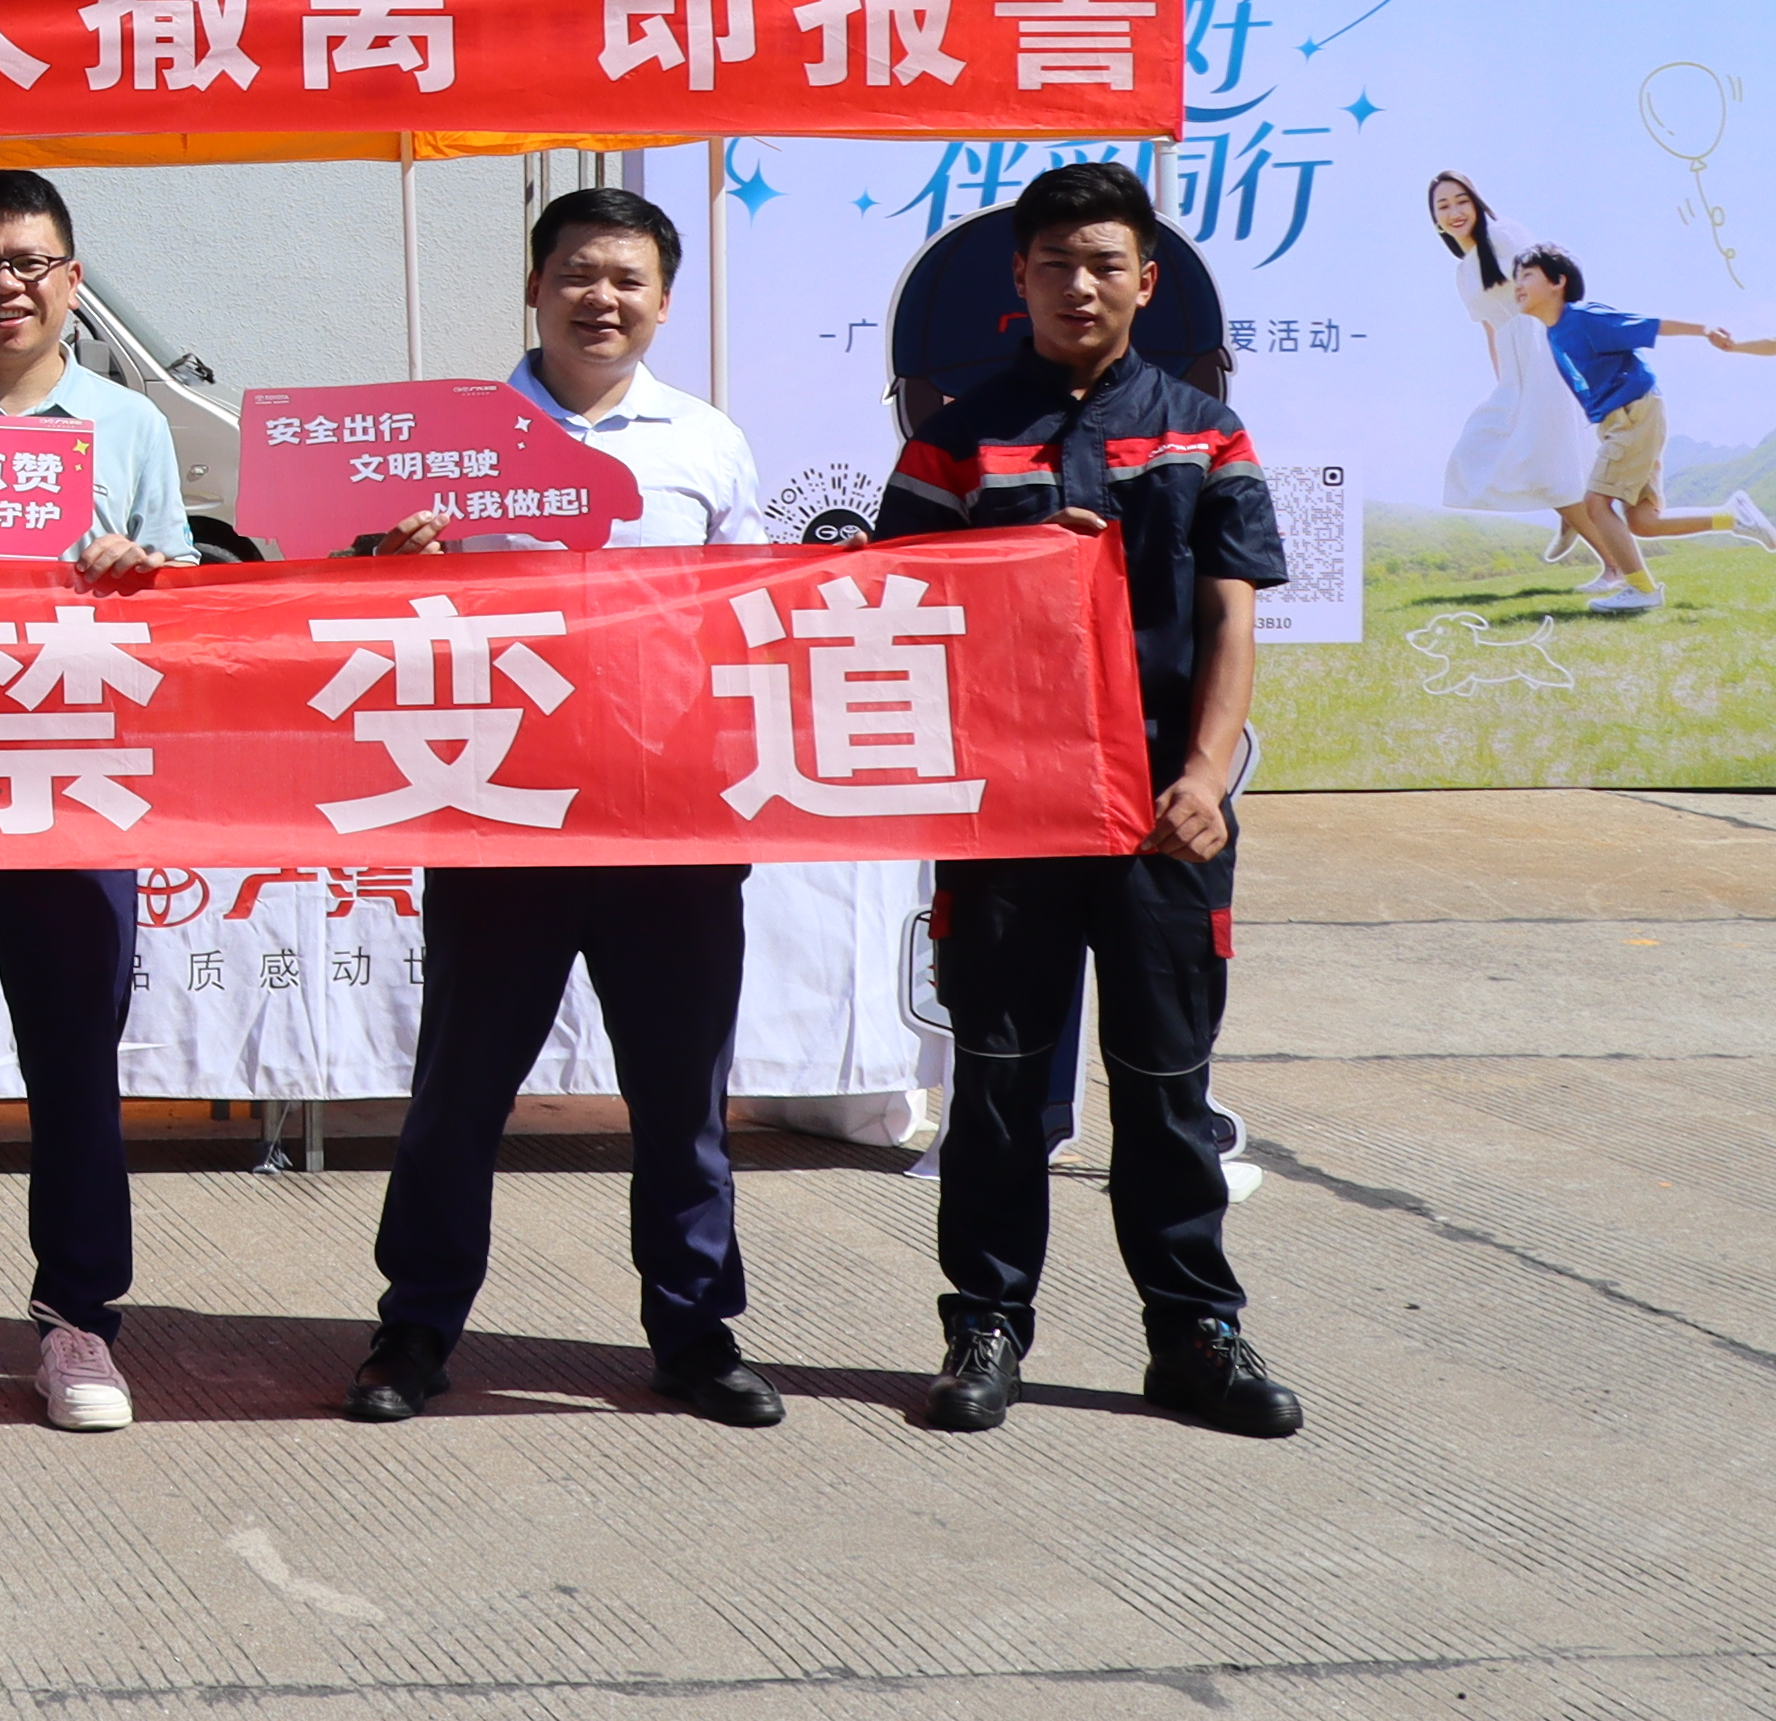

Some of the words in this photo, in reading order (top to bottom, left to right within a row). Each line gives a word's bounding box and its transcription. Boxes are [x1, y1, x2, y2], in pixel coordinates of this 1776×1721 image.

[266, 412, 416, 446] 安全出行
[349, 451, 500, 483] 文明驾驶
[431, 487, 590, 522] 从我做起!
